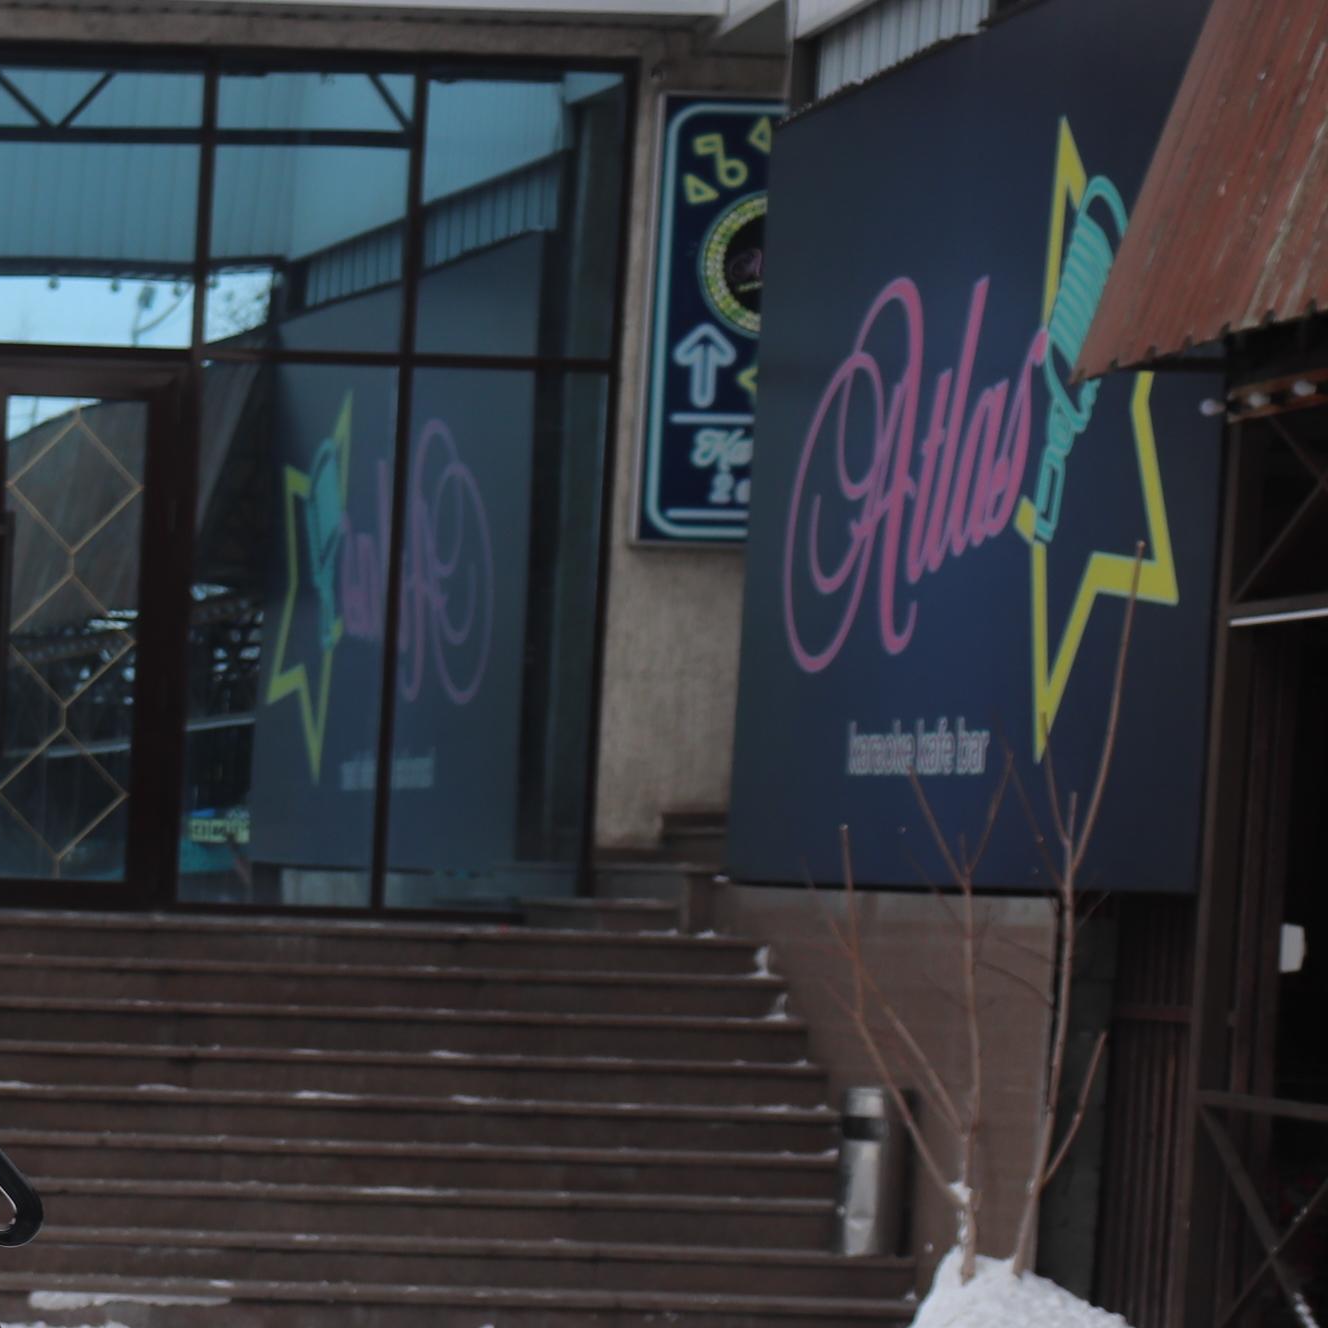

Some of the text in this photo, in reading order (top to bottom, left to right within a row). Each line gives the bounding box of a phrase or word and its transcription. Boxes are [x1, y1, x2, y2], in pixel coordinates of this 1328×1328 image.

[782, 275, 1048, 672] Atlas
[849, 715, 990, 775] karaoke kafe bar
